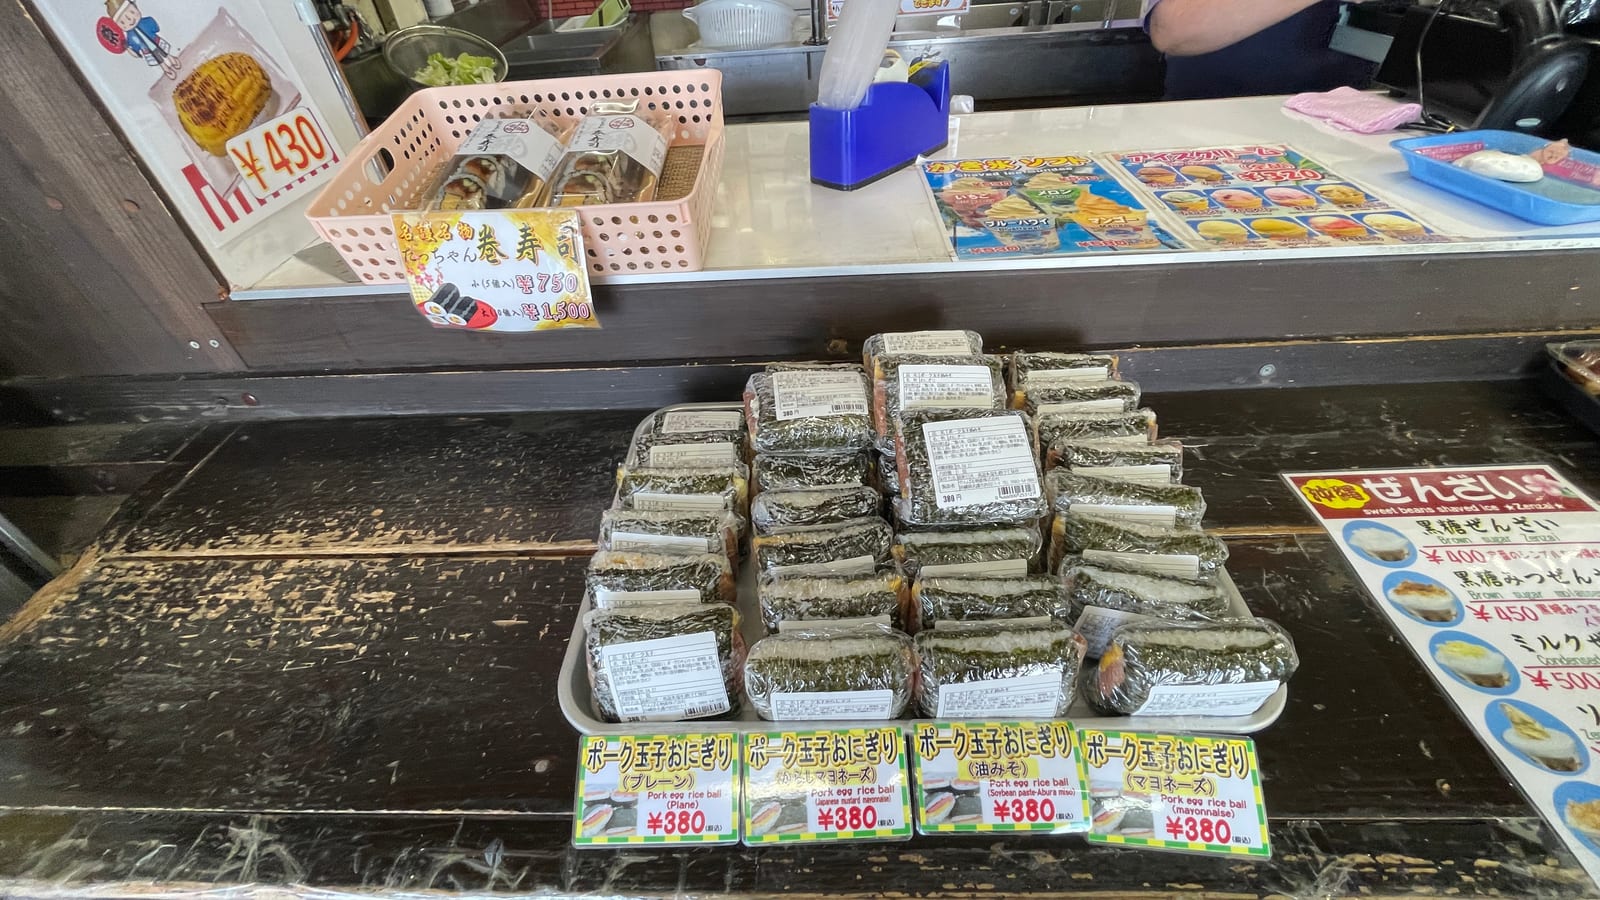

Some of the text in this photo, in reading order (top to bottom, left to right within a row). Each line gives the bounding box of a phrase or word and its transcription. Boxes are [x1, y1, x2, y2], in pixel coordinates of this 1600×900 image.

[231, 115, 325, 190] ¥430
[927, 155, 1093, 173] かき氷 ソフト
[985, 218, 1049, 227] ブルーハワイ
[1088, 216, 1139, 224] マンゴー
[515, 273, 578, 294] ¥750
[522, 301, 590, 321] ¥1,500
[1360, 475, 1530, 505] ぜんざい
[1363, 506, 1398, 515] sweet
[1400, 505, 1435, 514] beans
[1438, 504, 1479, 513] shaved
[1416, 516, 1560, 536] 黒糖ぜんざい
[1437, 535, 1472, 544] Brown
[1481, 535, 1512, 544] sugar
[1419, 549, 1487, 564] ¥400
[1467, 590, 1504, 600] Brown
[1513, 591, 1544, 600] sugar
[1465, 604, 1539, 622] ¥450
[748, 731, 898, 768] ポーク玉子おにぎり
[919, 725, 1072, 759] ポーク玉子おにぎり
[586, 737, 732, 771] ポーク玉子おにぎり
[1086, 736, 1249, 776] ポーク玉子おにぎり
[967, 760, 1028, 778] (油みそ)
[622, 773, 695, 791] (プレーン)
[811, 785, 895, 797] Pork egg rice ball
[990, 779, 1011, 787] Pork
[1033, 778, 1050, 787] rice
[1053, 778, 1069, 786] ball
[1126, 774, 1215, 795] (マヨネーズ)
[648, 791, 667, 799] Pork
[688, 791, 704, 799] rice
[707, 790, 722, 798] ball
[1161, 794, 1247, 809] Pork egg rice ball
[667, 800, 699, 809] (Plane)
[994, 798, 1055, 823] ¥380
[1172, 804, 1235, 818] (mayonnaise)
[647, 810, 705, 835] ¥380
[818, 805, 877, 831] ¥380
[1166, 815, 1231, 844] ¥380
